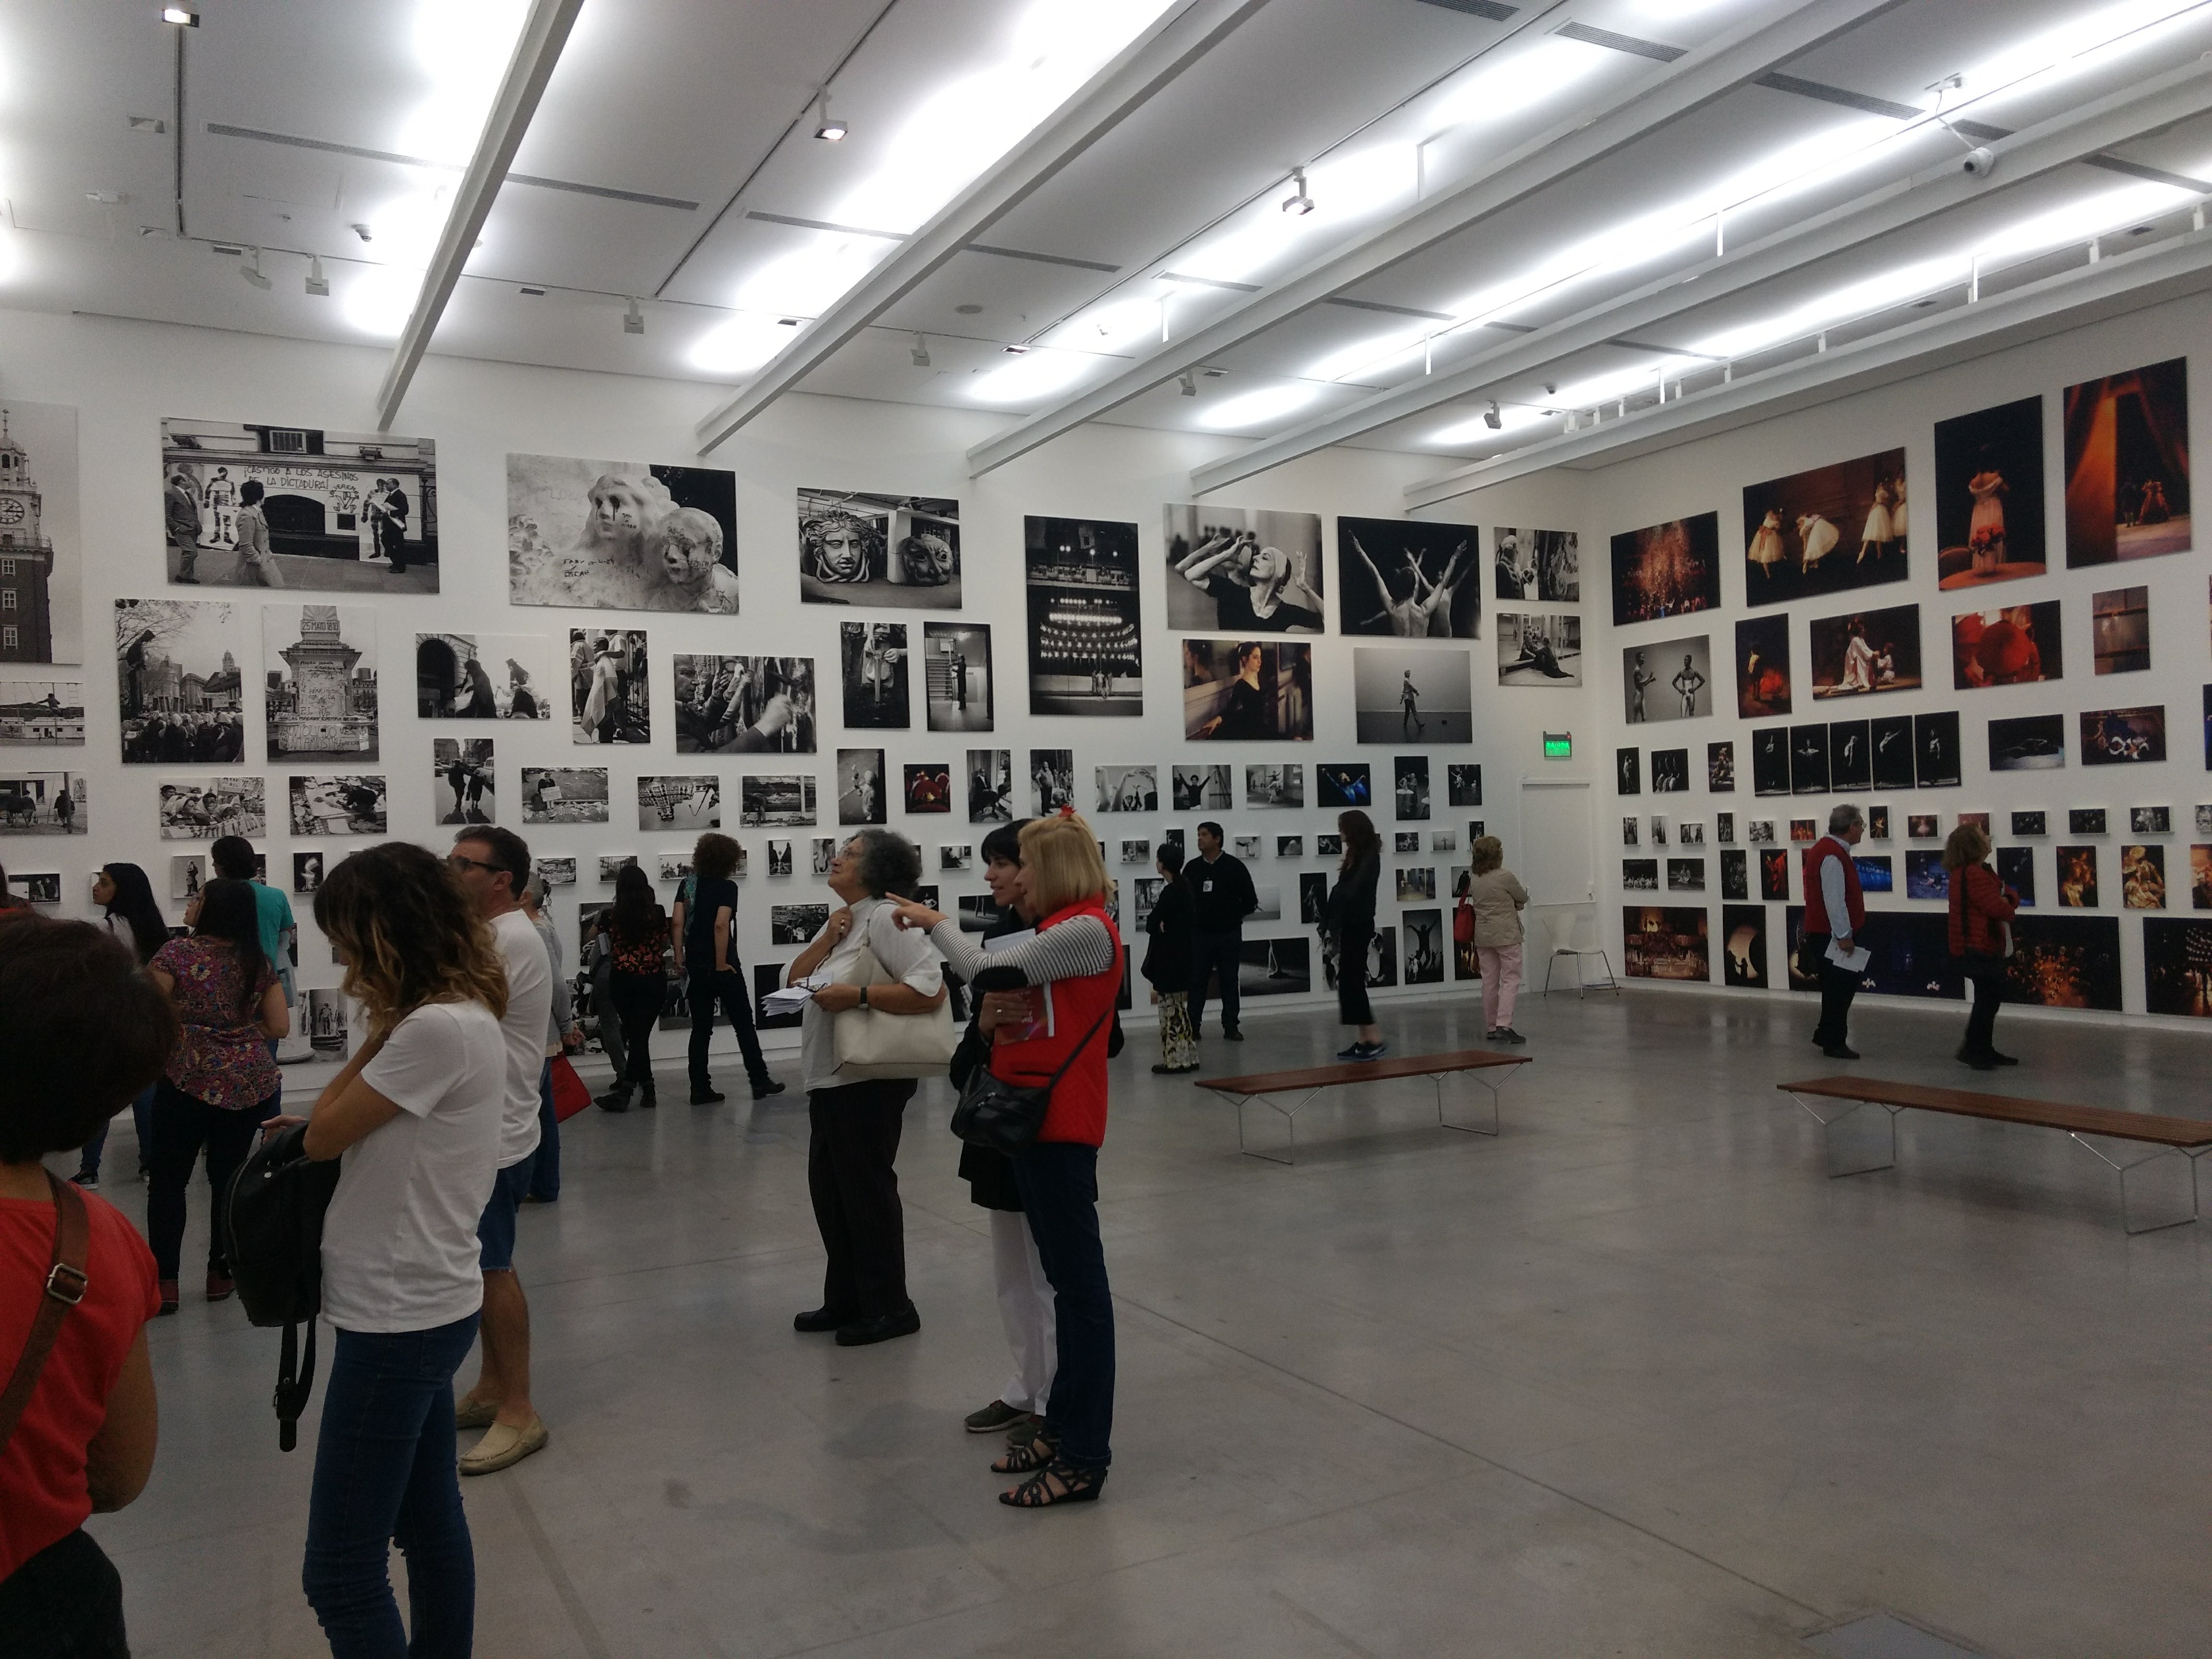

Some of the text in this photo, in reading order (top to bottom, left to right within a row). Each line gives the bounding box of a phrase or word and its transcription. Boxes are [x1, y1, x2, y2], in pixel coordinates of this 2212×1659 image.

[296, 469, 312, 477] LOS
[317, 469, 359, 481] ASESINOS
[266, 477, 276, 485] LA
[302, 621, 311, 630] 25
[311, 621, 326, 630] MAYO
